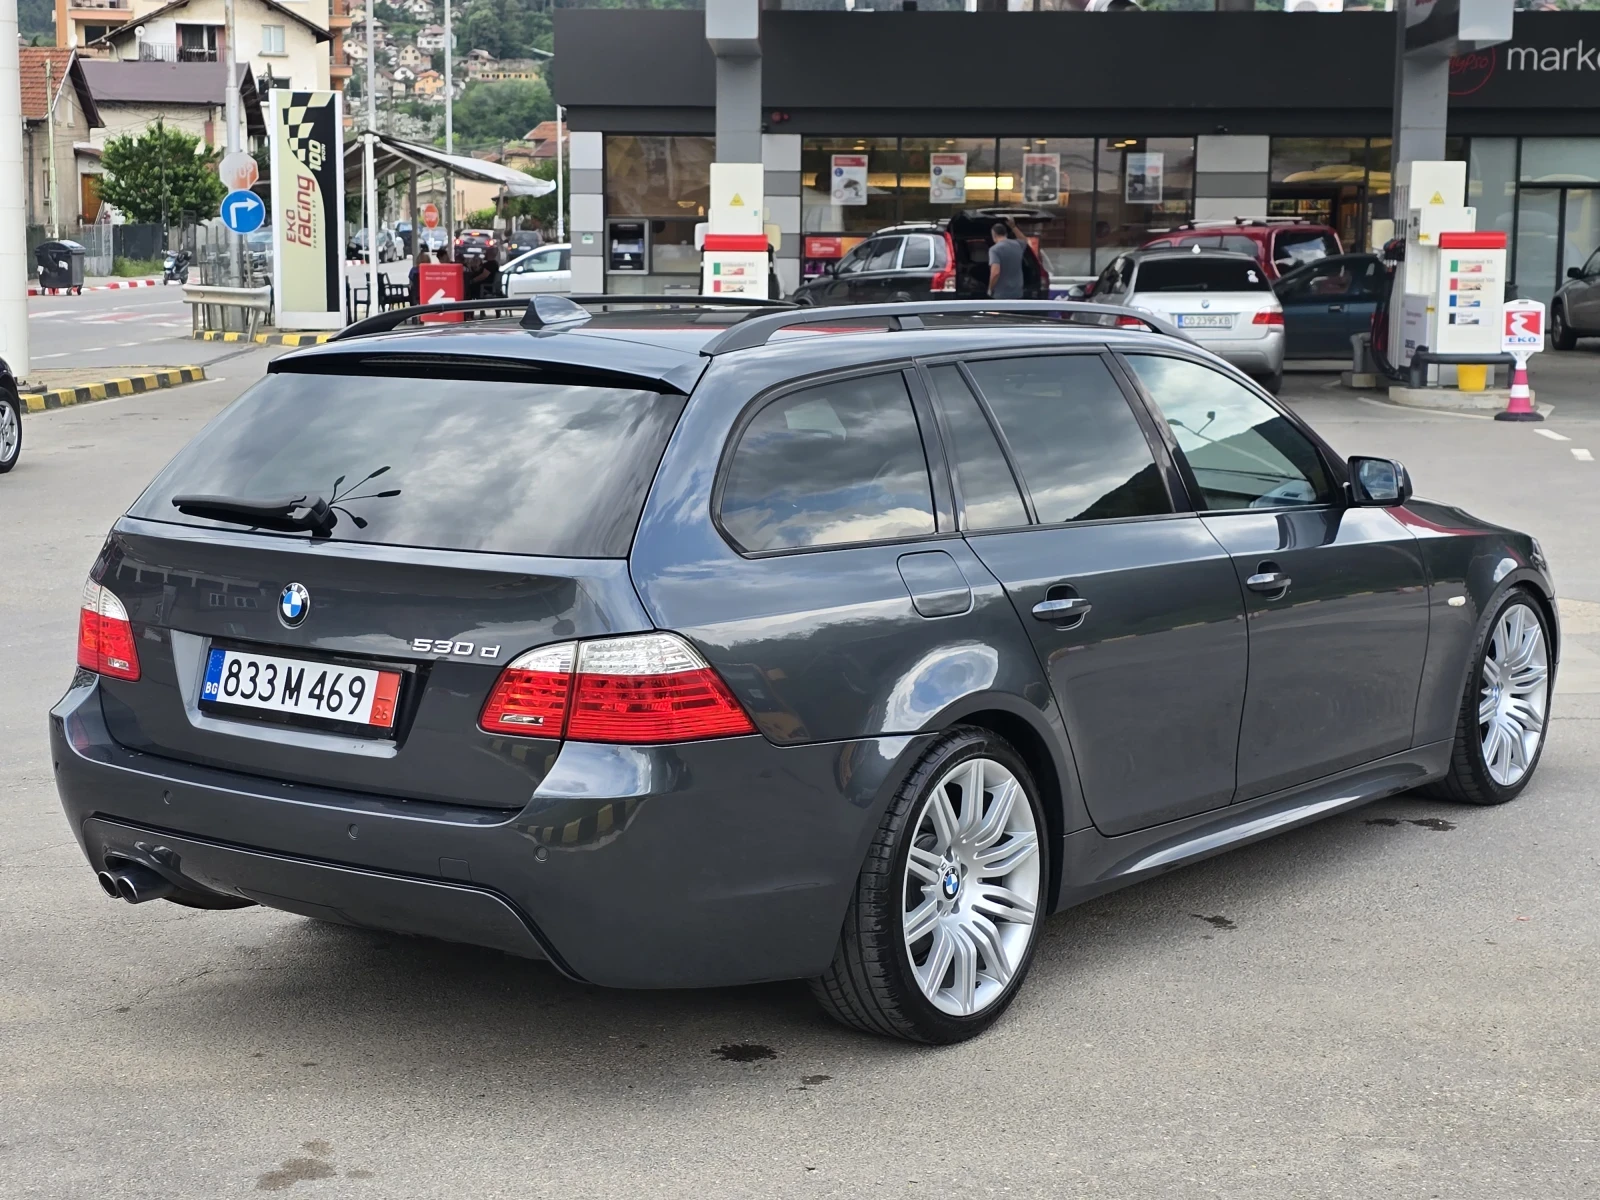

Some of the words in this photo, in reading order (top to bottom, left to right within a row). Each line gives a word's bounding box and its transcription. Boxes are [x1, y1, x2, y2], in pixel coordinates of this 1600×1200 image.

[1507, 39, 1600, 71] mark
[308, 139, 322, 171] 100
[286, 209, 297, 244] EKO
[296, 174, 316, 248] racing
[411, 637, 475, 655] 530
[479, 644, 501, 659] d
[204, 681, 219, 694] BG
[223, 658, 278, 702] 833
[281, 665, 306, 707] M
[307, 670, 367, 715] 469
[373, 706, 389, 720] 26
